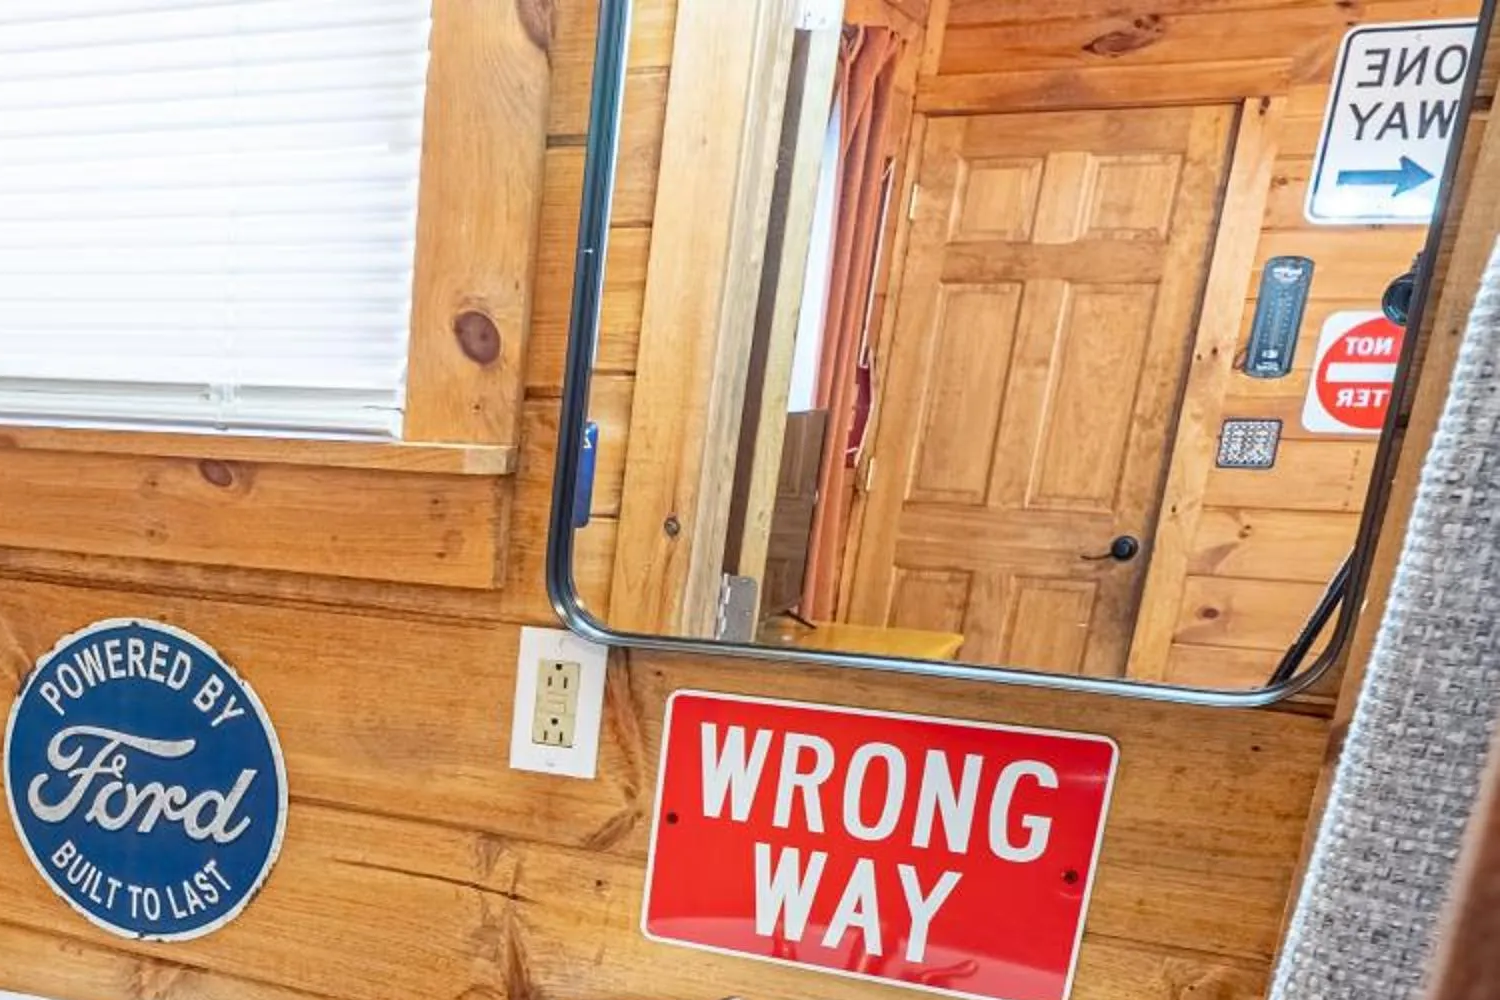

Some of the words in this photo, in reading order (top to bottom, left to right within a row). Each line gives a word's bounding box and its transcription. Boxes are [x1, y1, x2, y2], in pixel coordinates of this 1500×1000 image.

[39, 637, 192, 716] POWERED
[192, 673, 245, 727] BY
[27, 725, 257, 843] Ford
[700, 721, 1060, 863] WRONG
[51, 840, 122, 910] BUILT
[127, 887, 160, 920] TO
[166, 859, 231, 919] LAST
[753, 841, 963, 963] WAY
